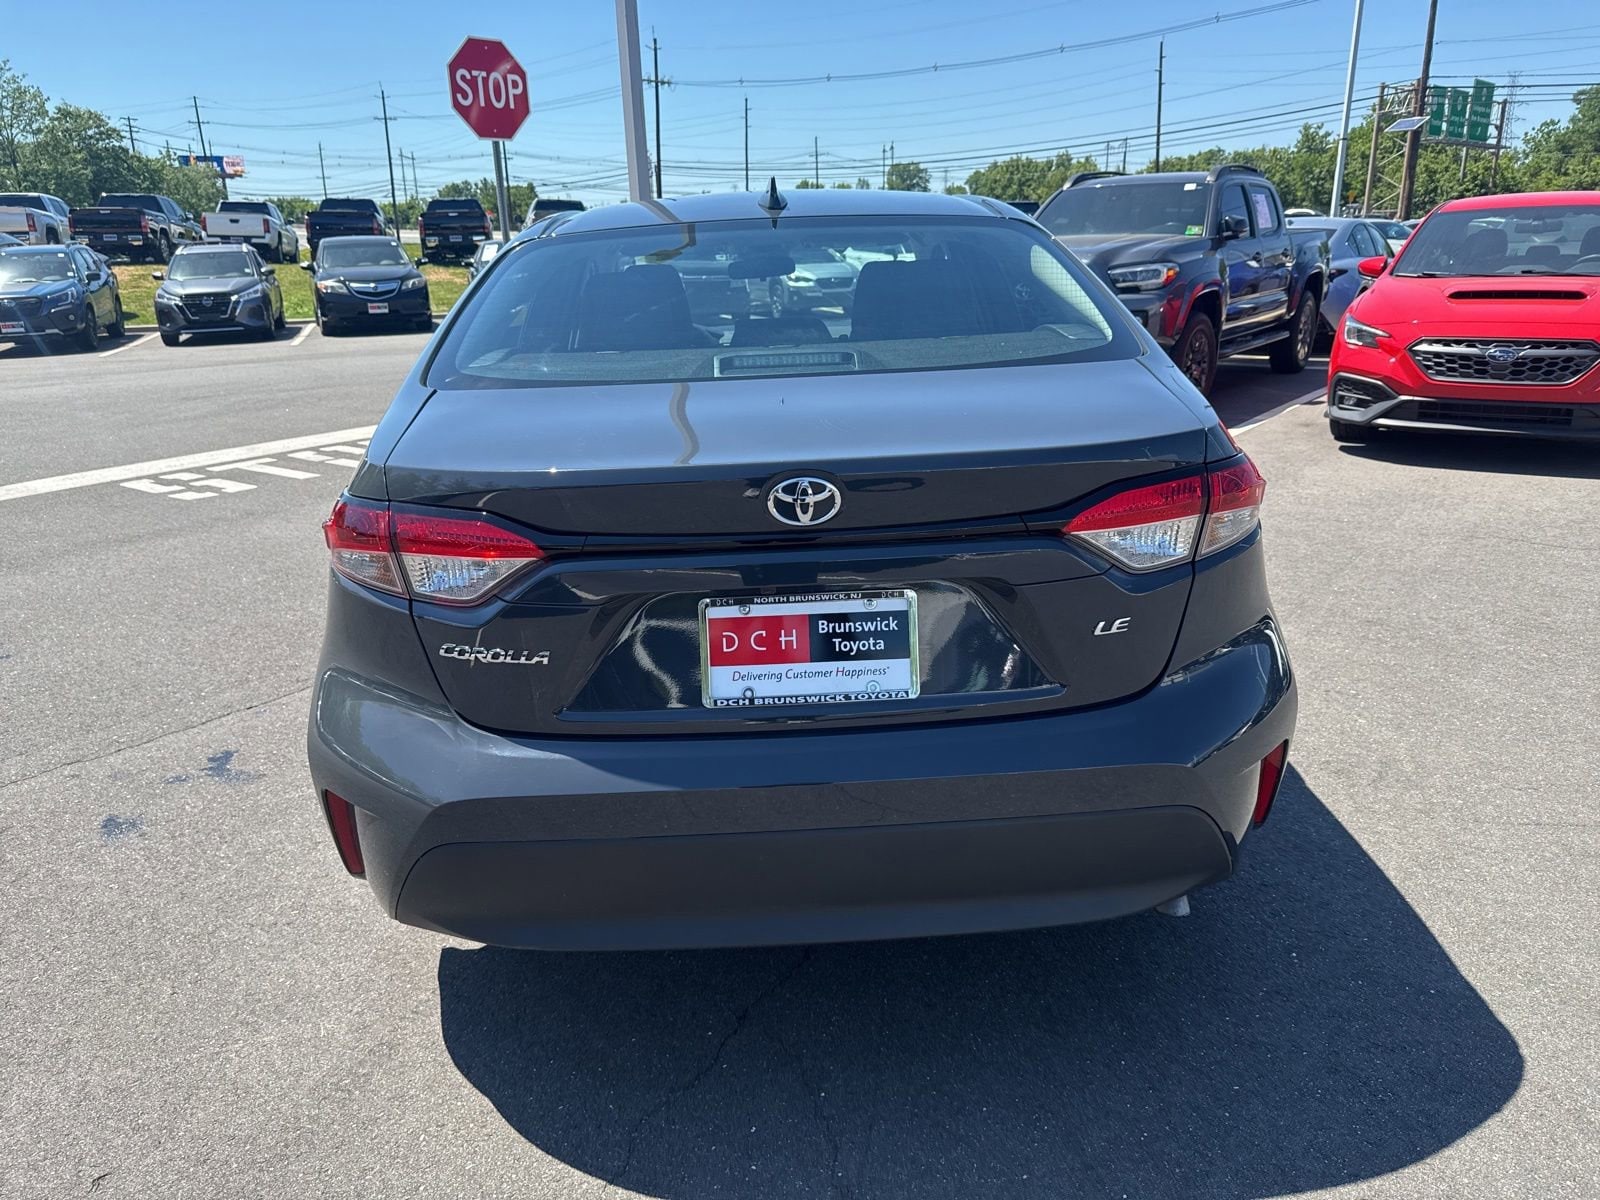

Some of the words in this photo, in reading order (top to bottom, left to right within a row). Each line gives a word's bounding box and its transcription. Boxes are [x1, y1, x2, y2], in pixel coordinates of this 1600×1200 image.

[455, 68, 524, 110] STOP
[120, 439, 371, 500] STO
[753, 596, 787, 604] NORTH
[818, 616, 899, 634] Brunswick
[1094, 616, 1131, 636] LE
[439, 643, 551, 665] COROLLA
[832, 637, 885, 656] Toyota
[732, 670, 783, 683] Delivering
[785, 668, 834, 680] Customer
[716, 698, 750, 706] DCH
[754, 693, 846, 705] BRUNSWICK
[848, 690, 908, 701] TOYOTA
